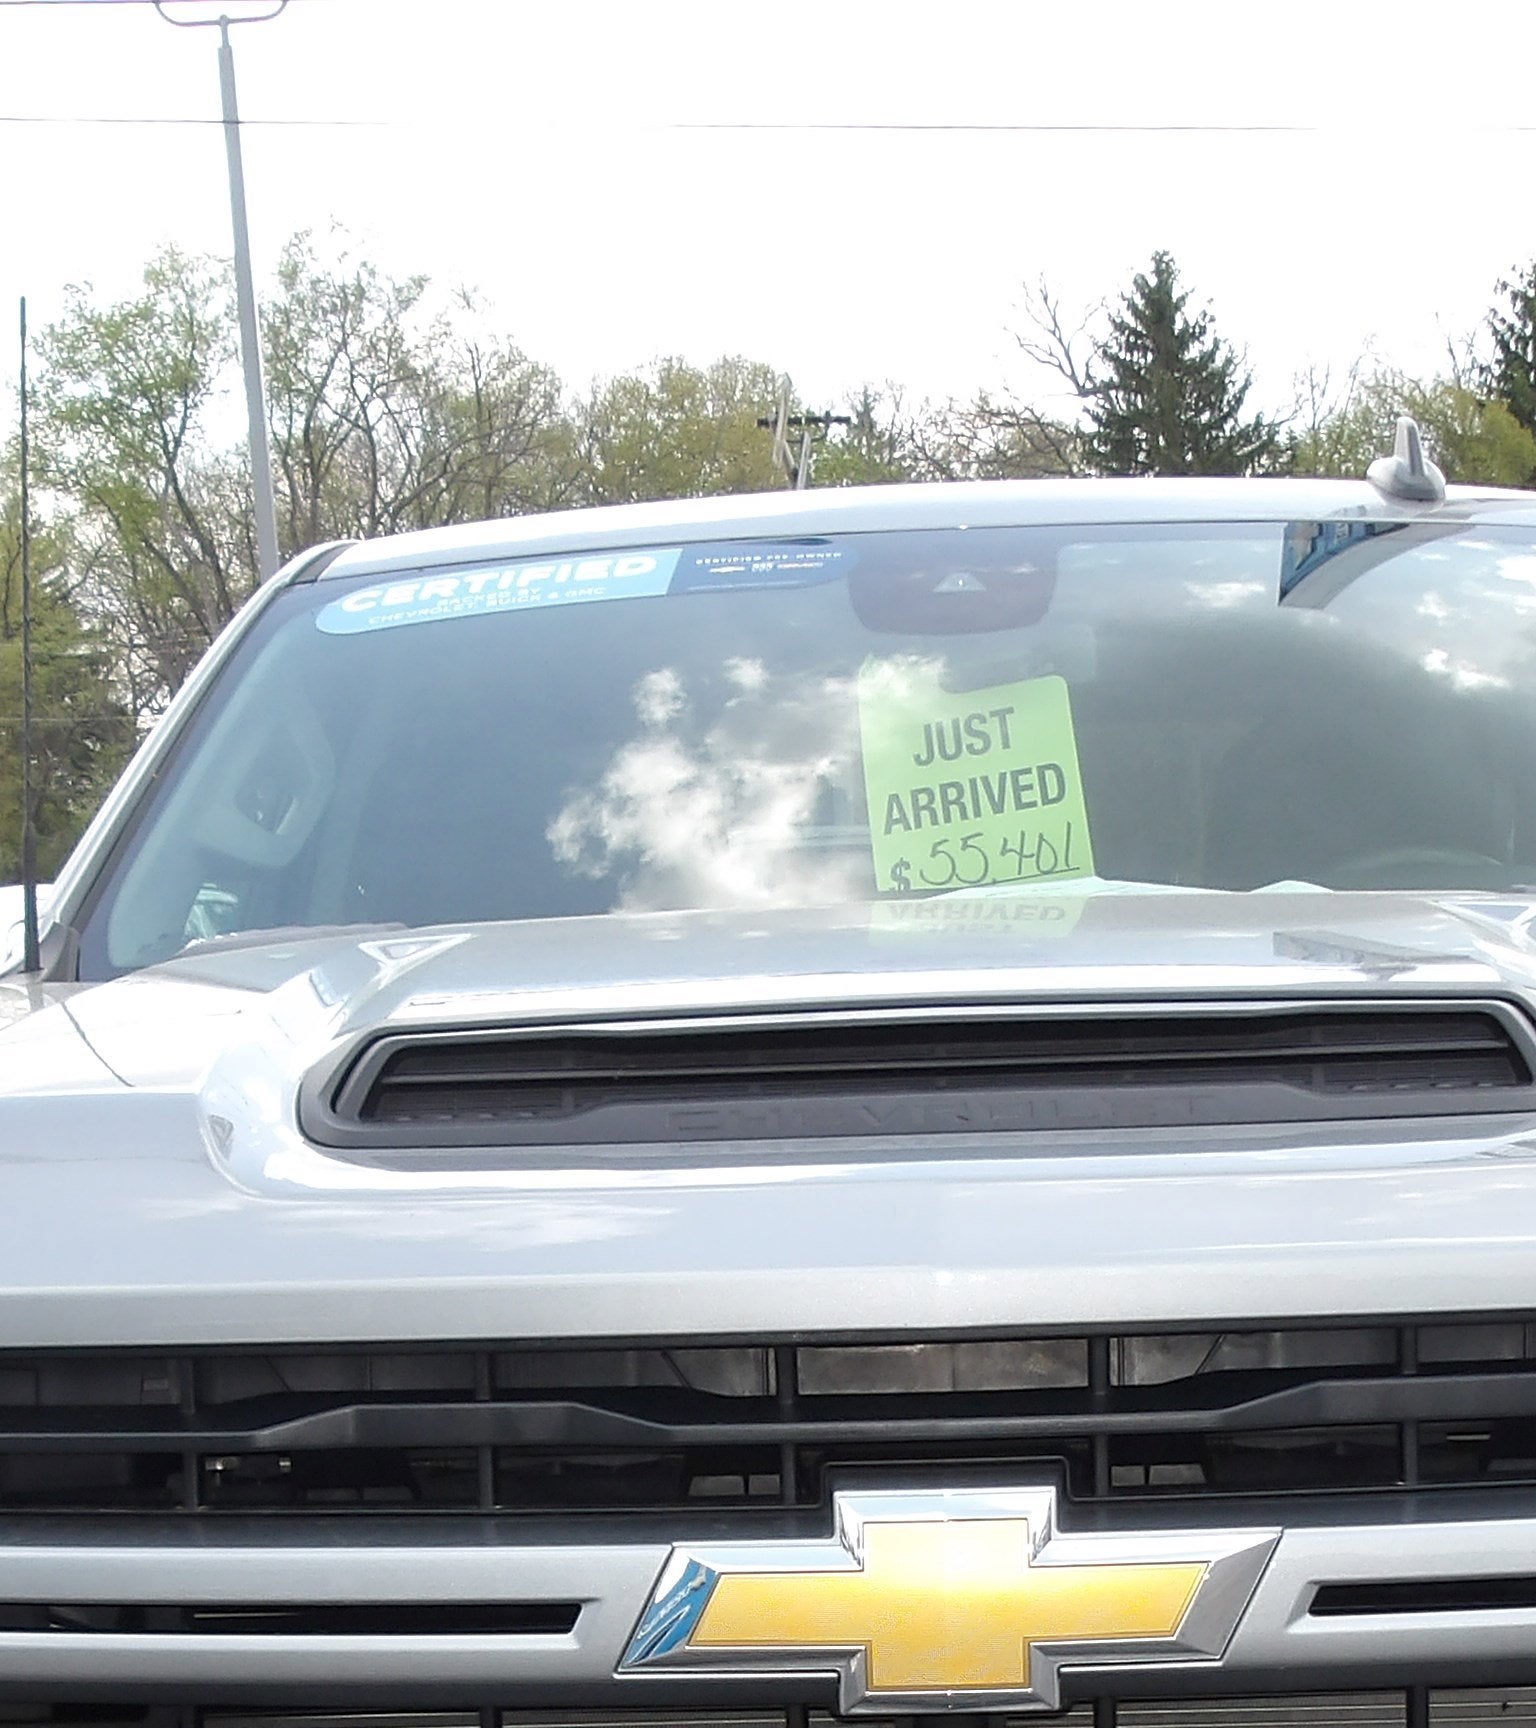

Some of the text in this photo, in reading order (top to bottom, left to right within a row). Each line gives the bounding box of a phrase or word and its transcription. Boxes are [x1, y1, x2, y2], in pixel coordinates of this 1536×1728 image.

[341, 556, 657, 613] CERTIFIED
[913, 707, 1014, 767] JUST
[883, 762, 1066, 836] ARRIVED
